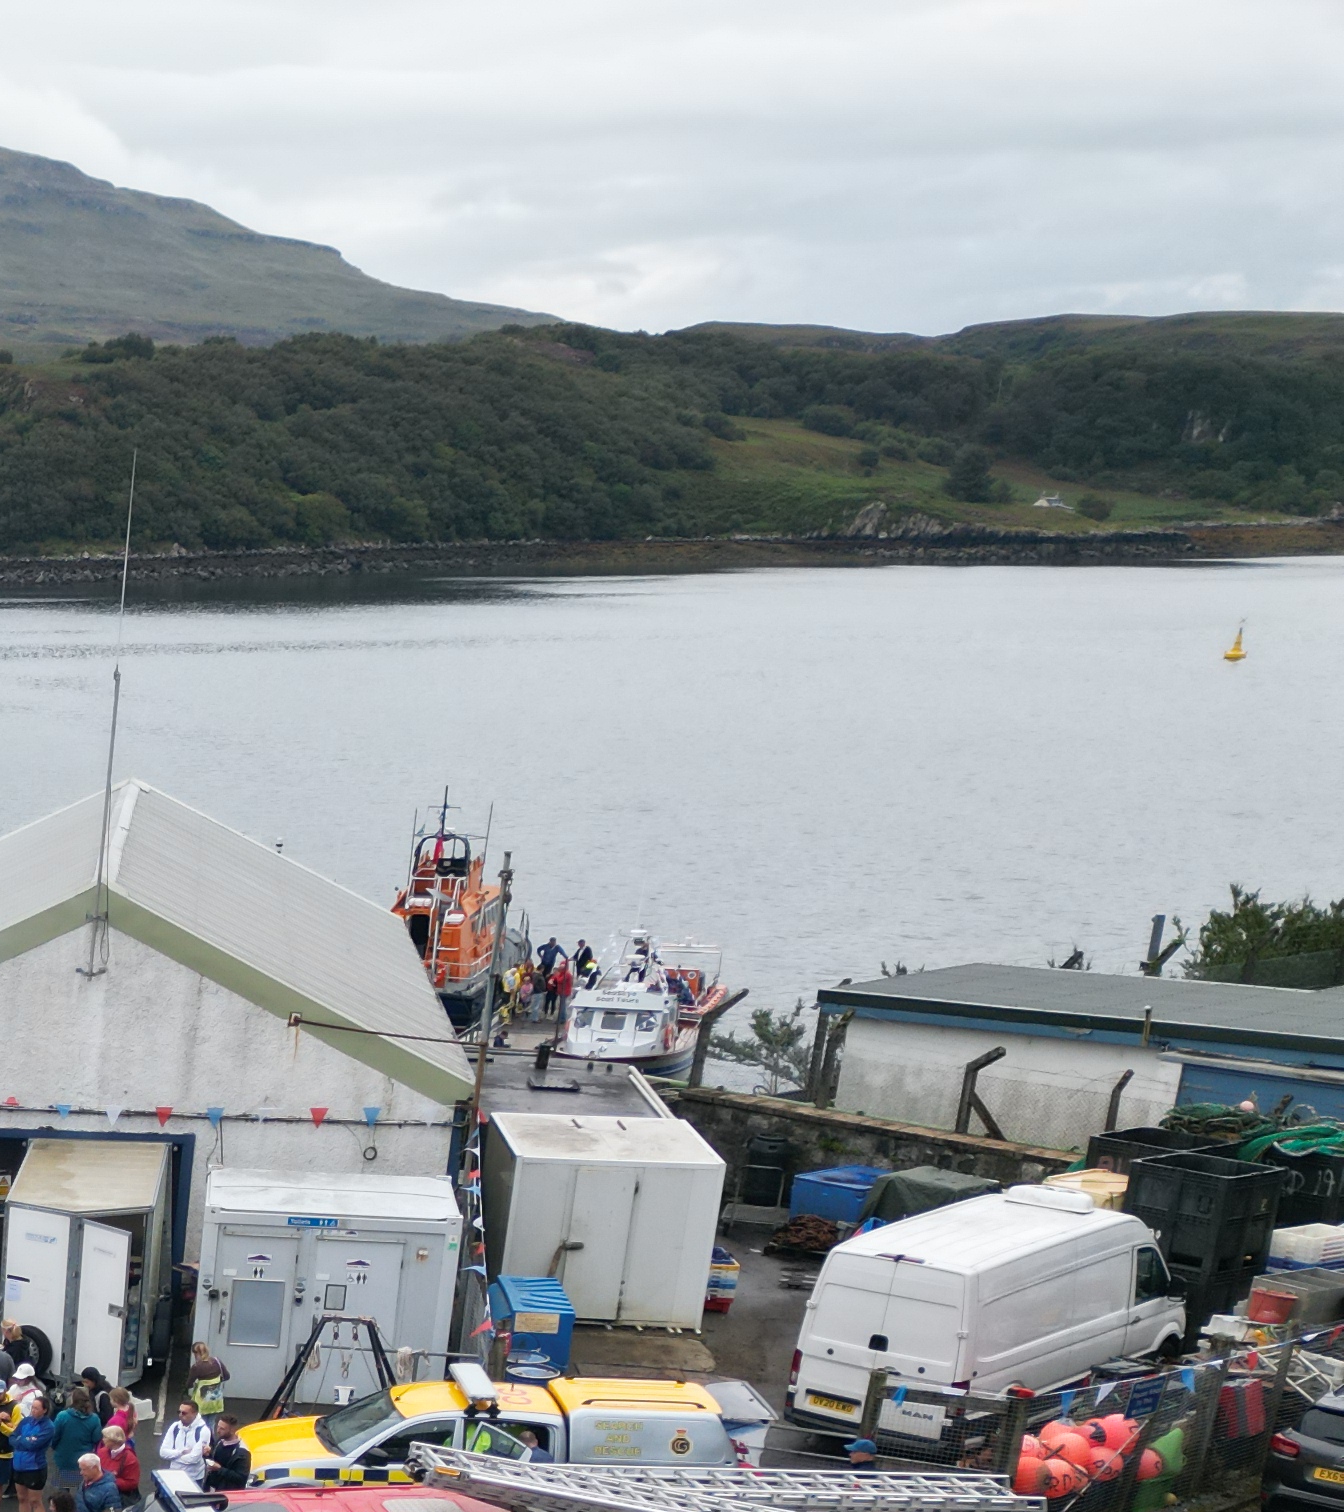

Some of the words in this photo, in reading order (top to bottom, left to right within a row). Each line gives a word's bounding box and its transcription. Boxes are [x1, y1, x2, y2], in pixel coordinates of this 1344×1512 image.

[902, 1409, 934, 1421] MAN
[595, 1421, 643, 1431] SEARCH
[606, 1434, 631, 1443] AND
[594, 1446, 642, 1456] RESCUE
